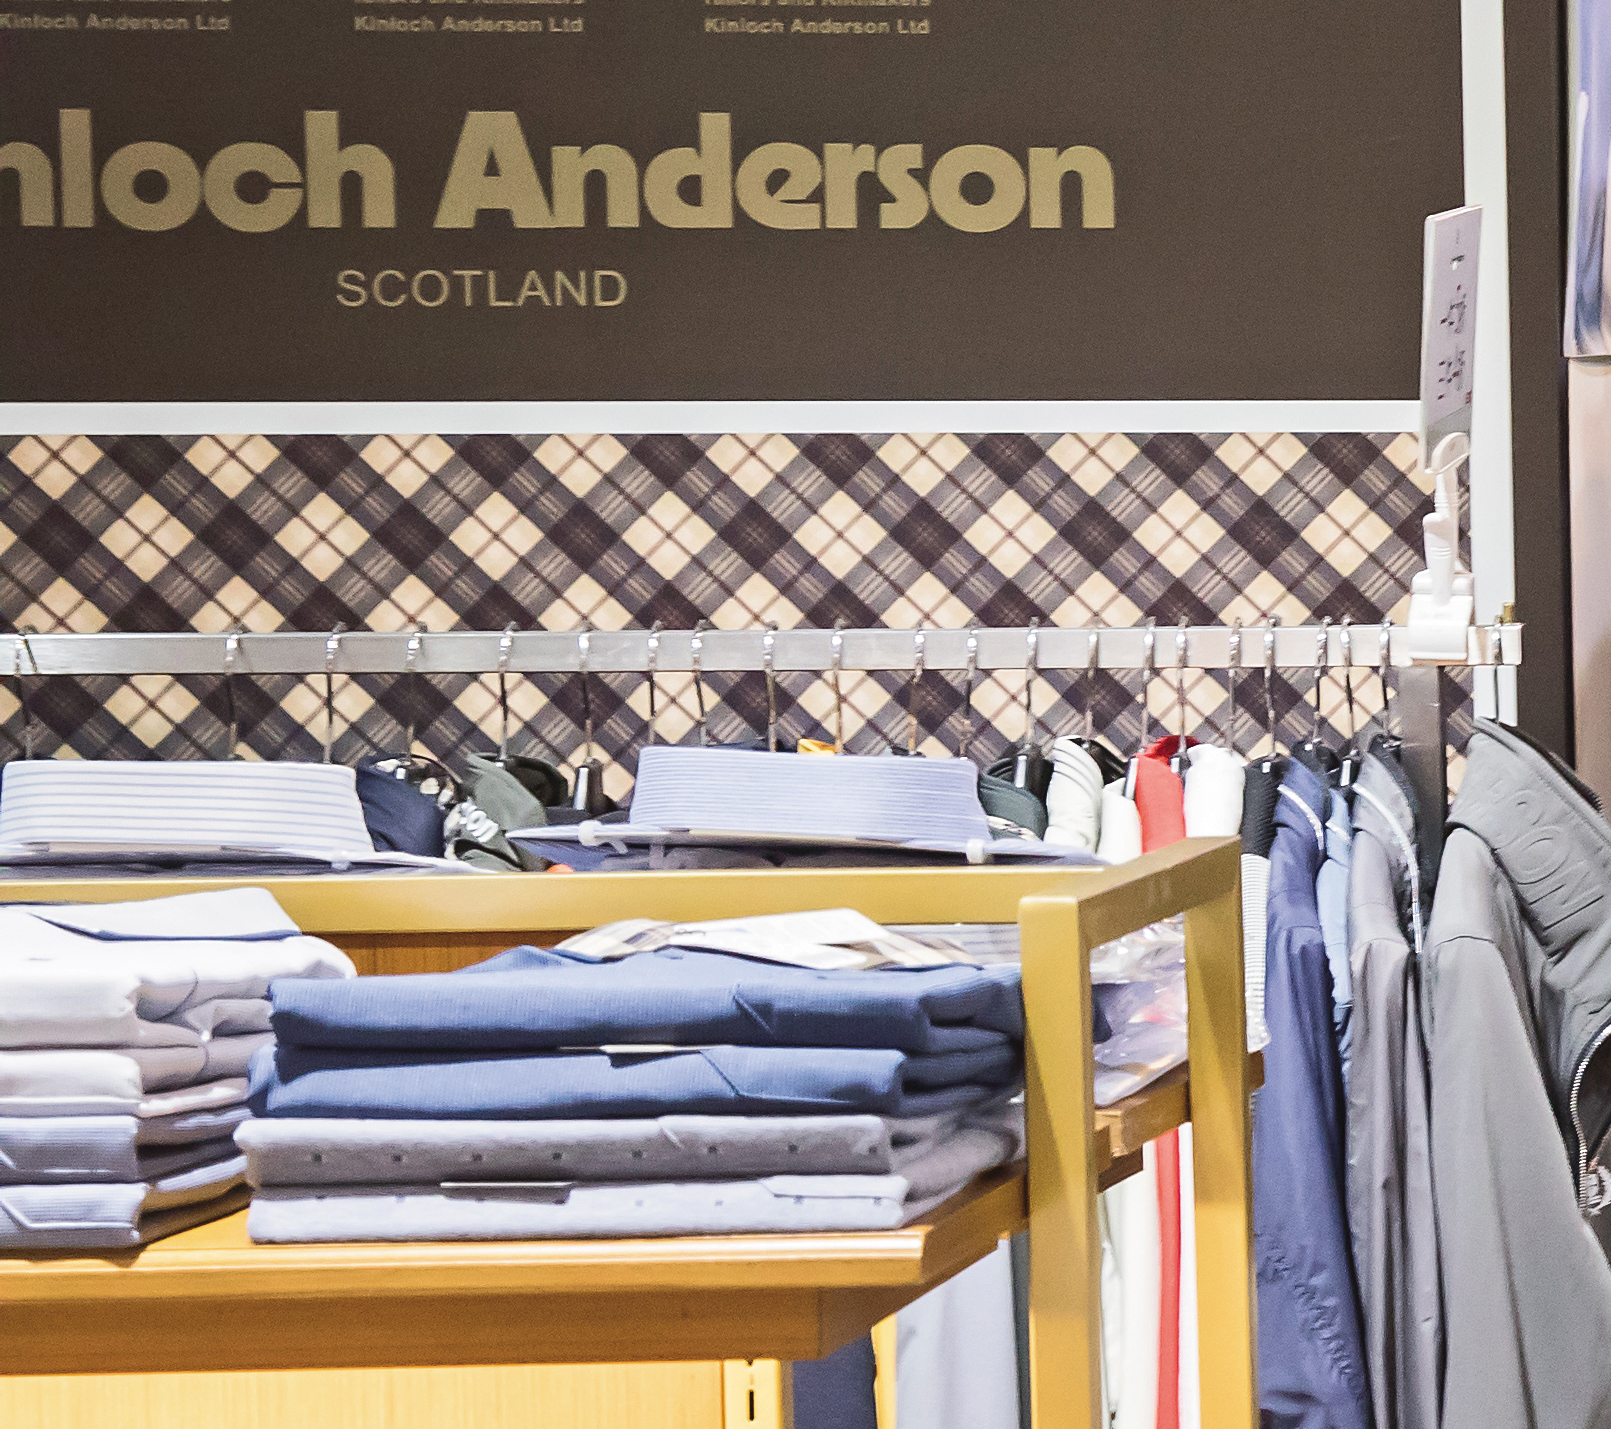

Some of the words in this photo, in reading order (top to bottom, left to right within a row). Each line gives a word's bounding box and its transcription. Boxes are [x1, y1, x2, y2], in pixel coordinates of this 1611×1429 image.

[86, 13, 188, 29] Anderson
[195, 14, 230, 30] Ltd
[354, 16, 436, 32] Kinloch
[439, 15, 543, 33] Anderson
[548, 17, 584, 33] Ltd
[704, 18, 785, 34] Kinloch
[790, 18, 891, 35] Anderson
[896, 18, 930, 35] Ltd
[0, 109, 396, 232] nloch
[433, 110, 1117, 233] Anderson
[337, 268, 628, 308] SCOTLAND
